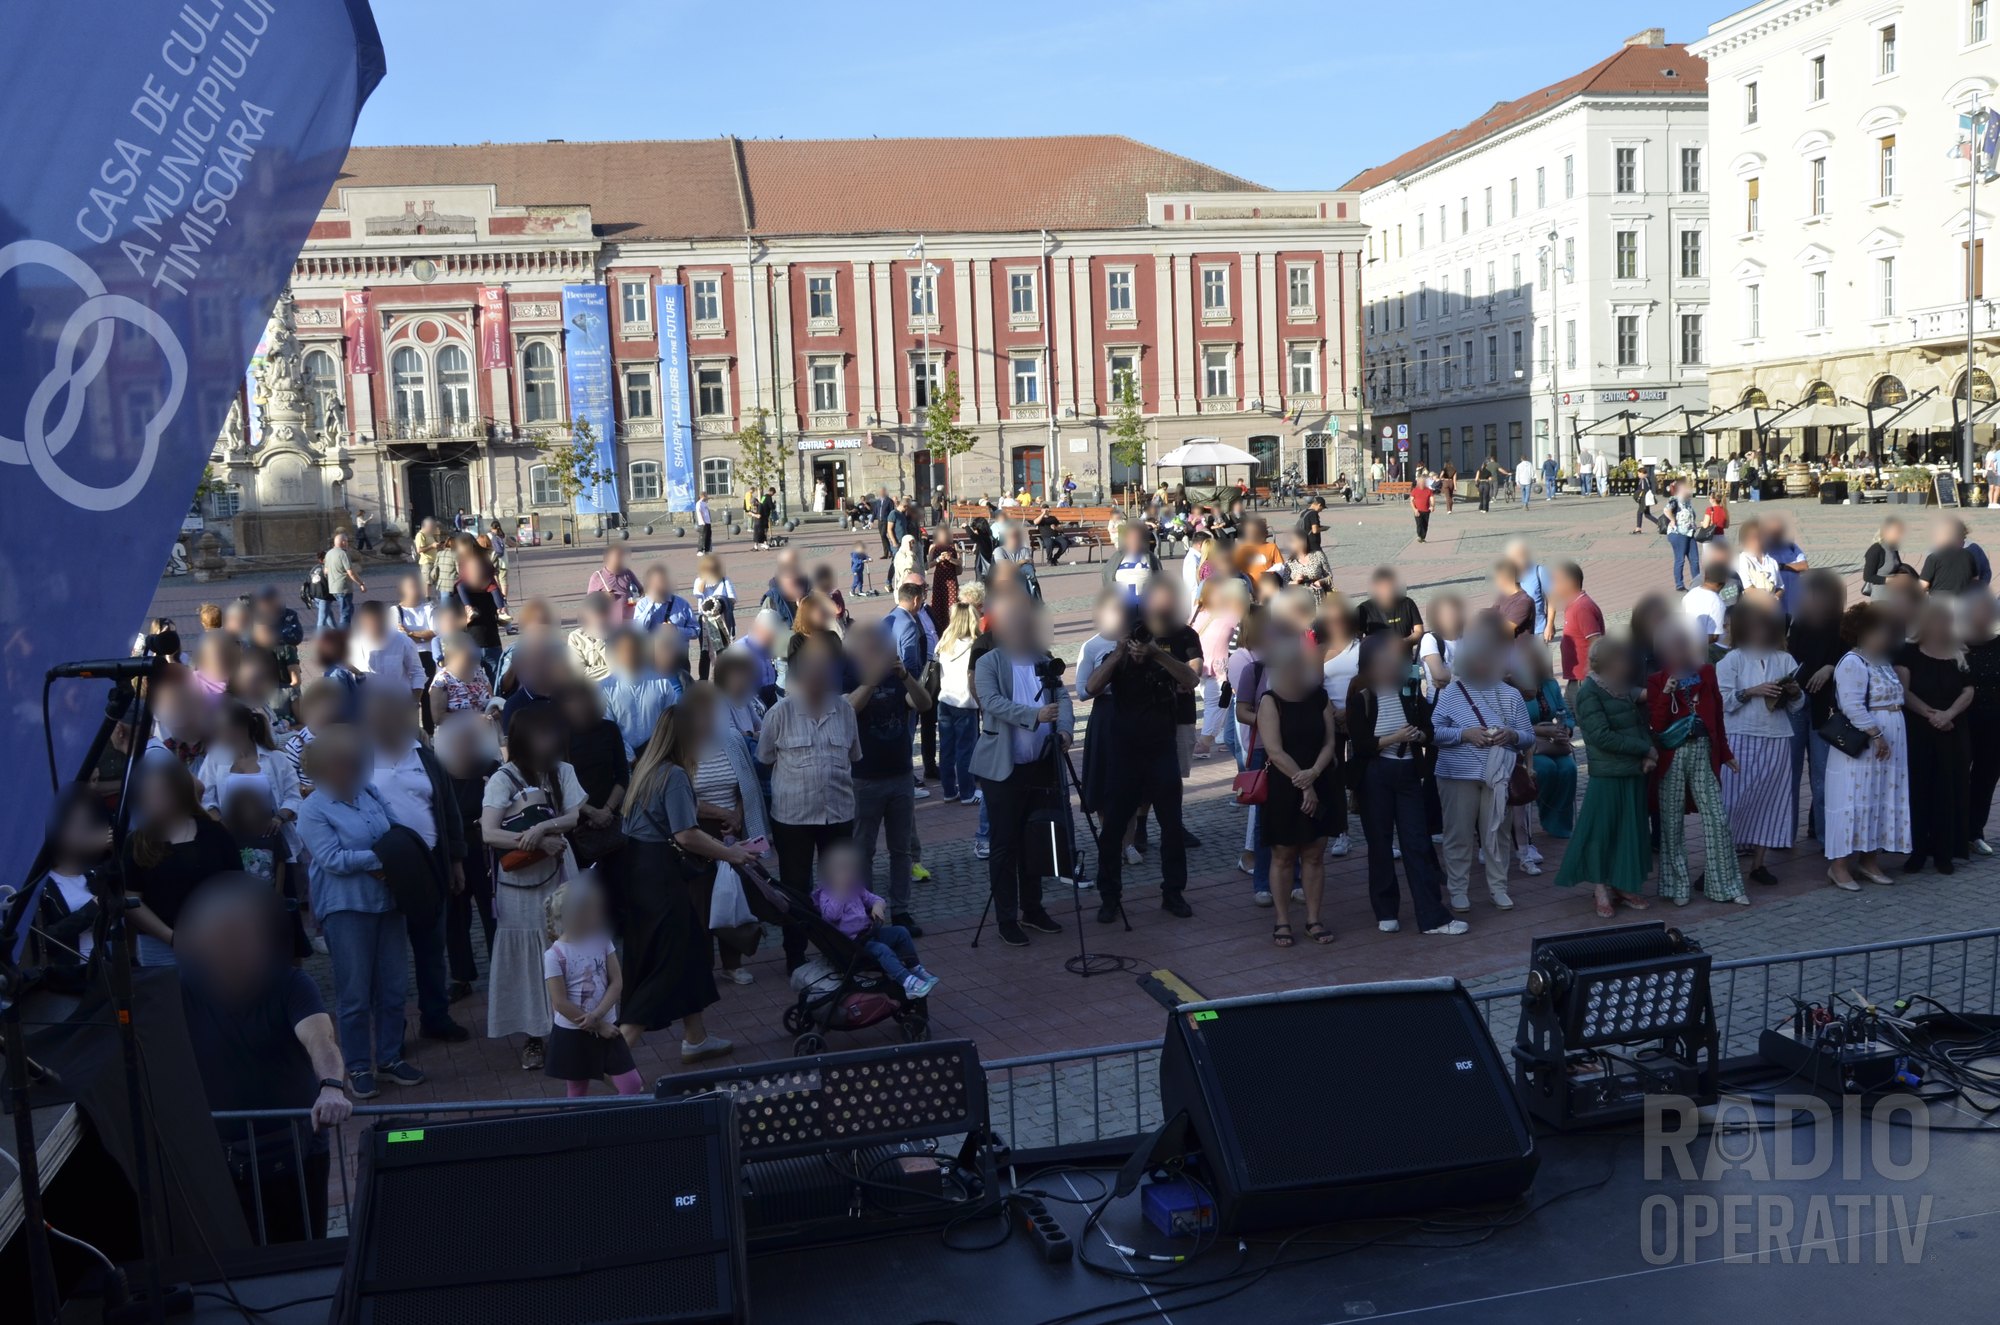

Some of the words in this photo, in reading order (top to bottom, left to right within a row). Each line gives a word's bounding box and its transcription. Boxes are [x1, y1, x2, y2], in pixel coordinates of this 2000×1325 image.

[76, 138, 152, 244] CASA
[130, 73, 180, 135] DE
[152, 100, 275, 297] TIMIȘOARA
[119, 240, 156, 278] A
[665, 296, 676, 338] FUTURE
[669, 367, 680, 419] LEADERS
[1601, 393, 1628, 403] CENTRAL
[1640, 391, 1667, 401] MARKET
[672, 420, 683, 468] SHAPING
[798, 441, 826, 450] CENTRAL
[834, 439, 862, 449] MARKET
[1455, 1060, 1473, 1071] RCF
[675, 1194, 697, 1207] RCF
